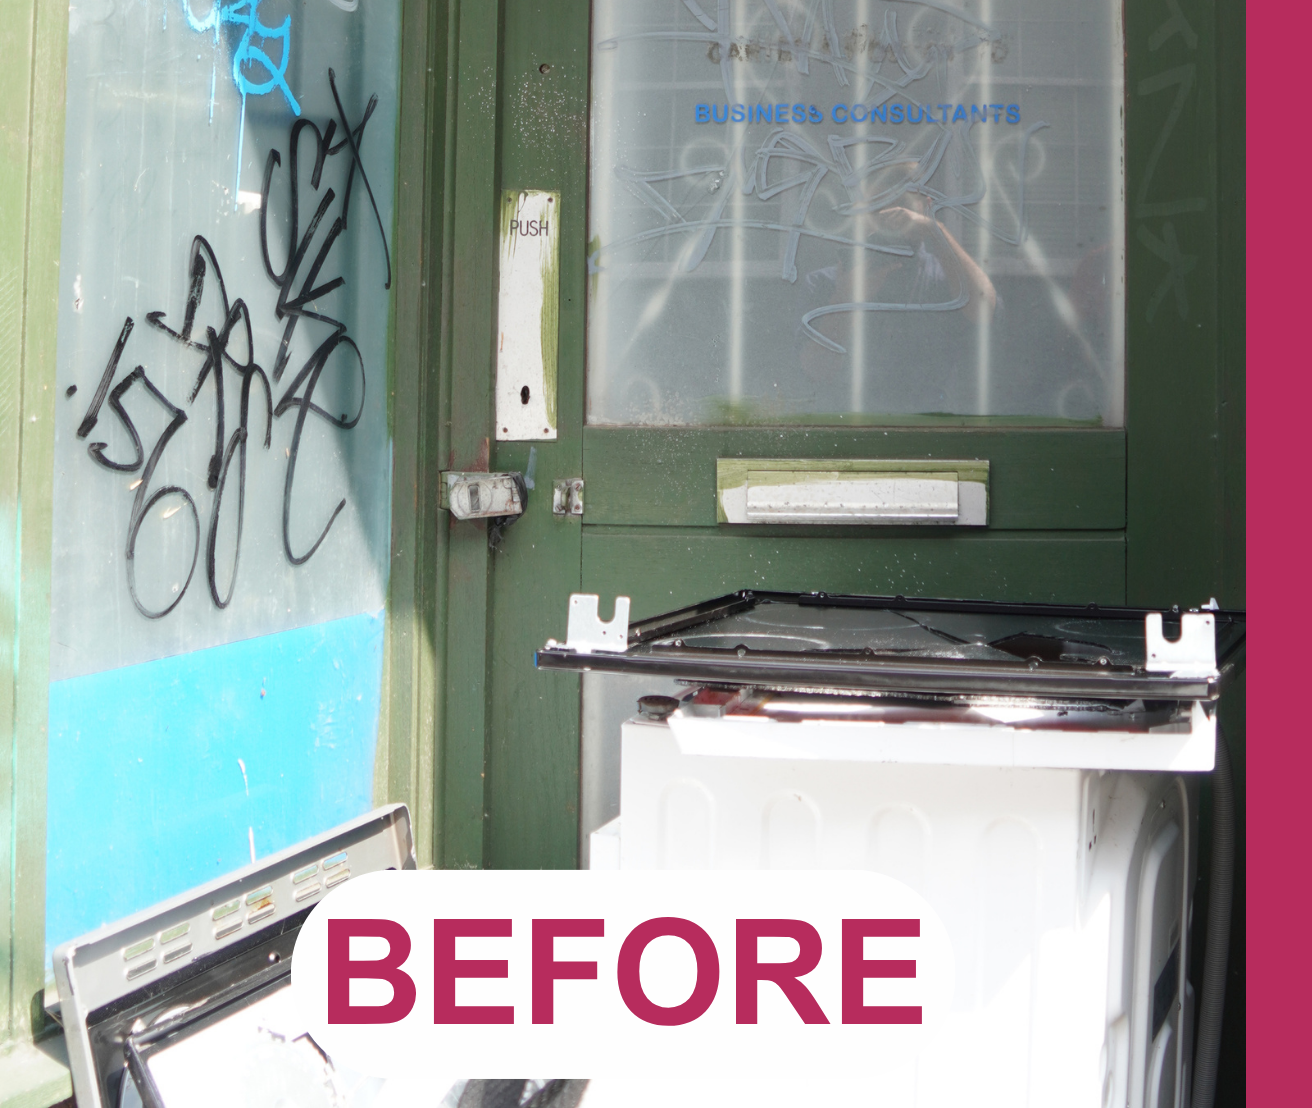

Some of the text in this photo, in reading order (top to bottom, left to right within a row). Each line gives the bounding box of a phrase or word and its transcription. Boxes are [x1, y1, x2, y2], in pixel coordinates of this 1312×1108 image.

[694, 103, 1021, 124] BUSINESS CONSULTANTS
[509, 220, 549, 237] PUSH
